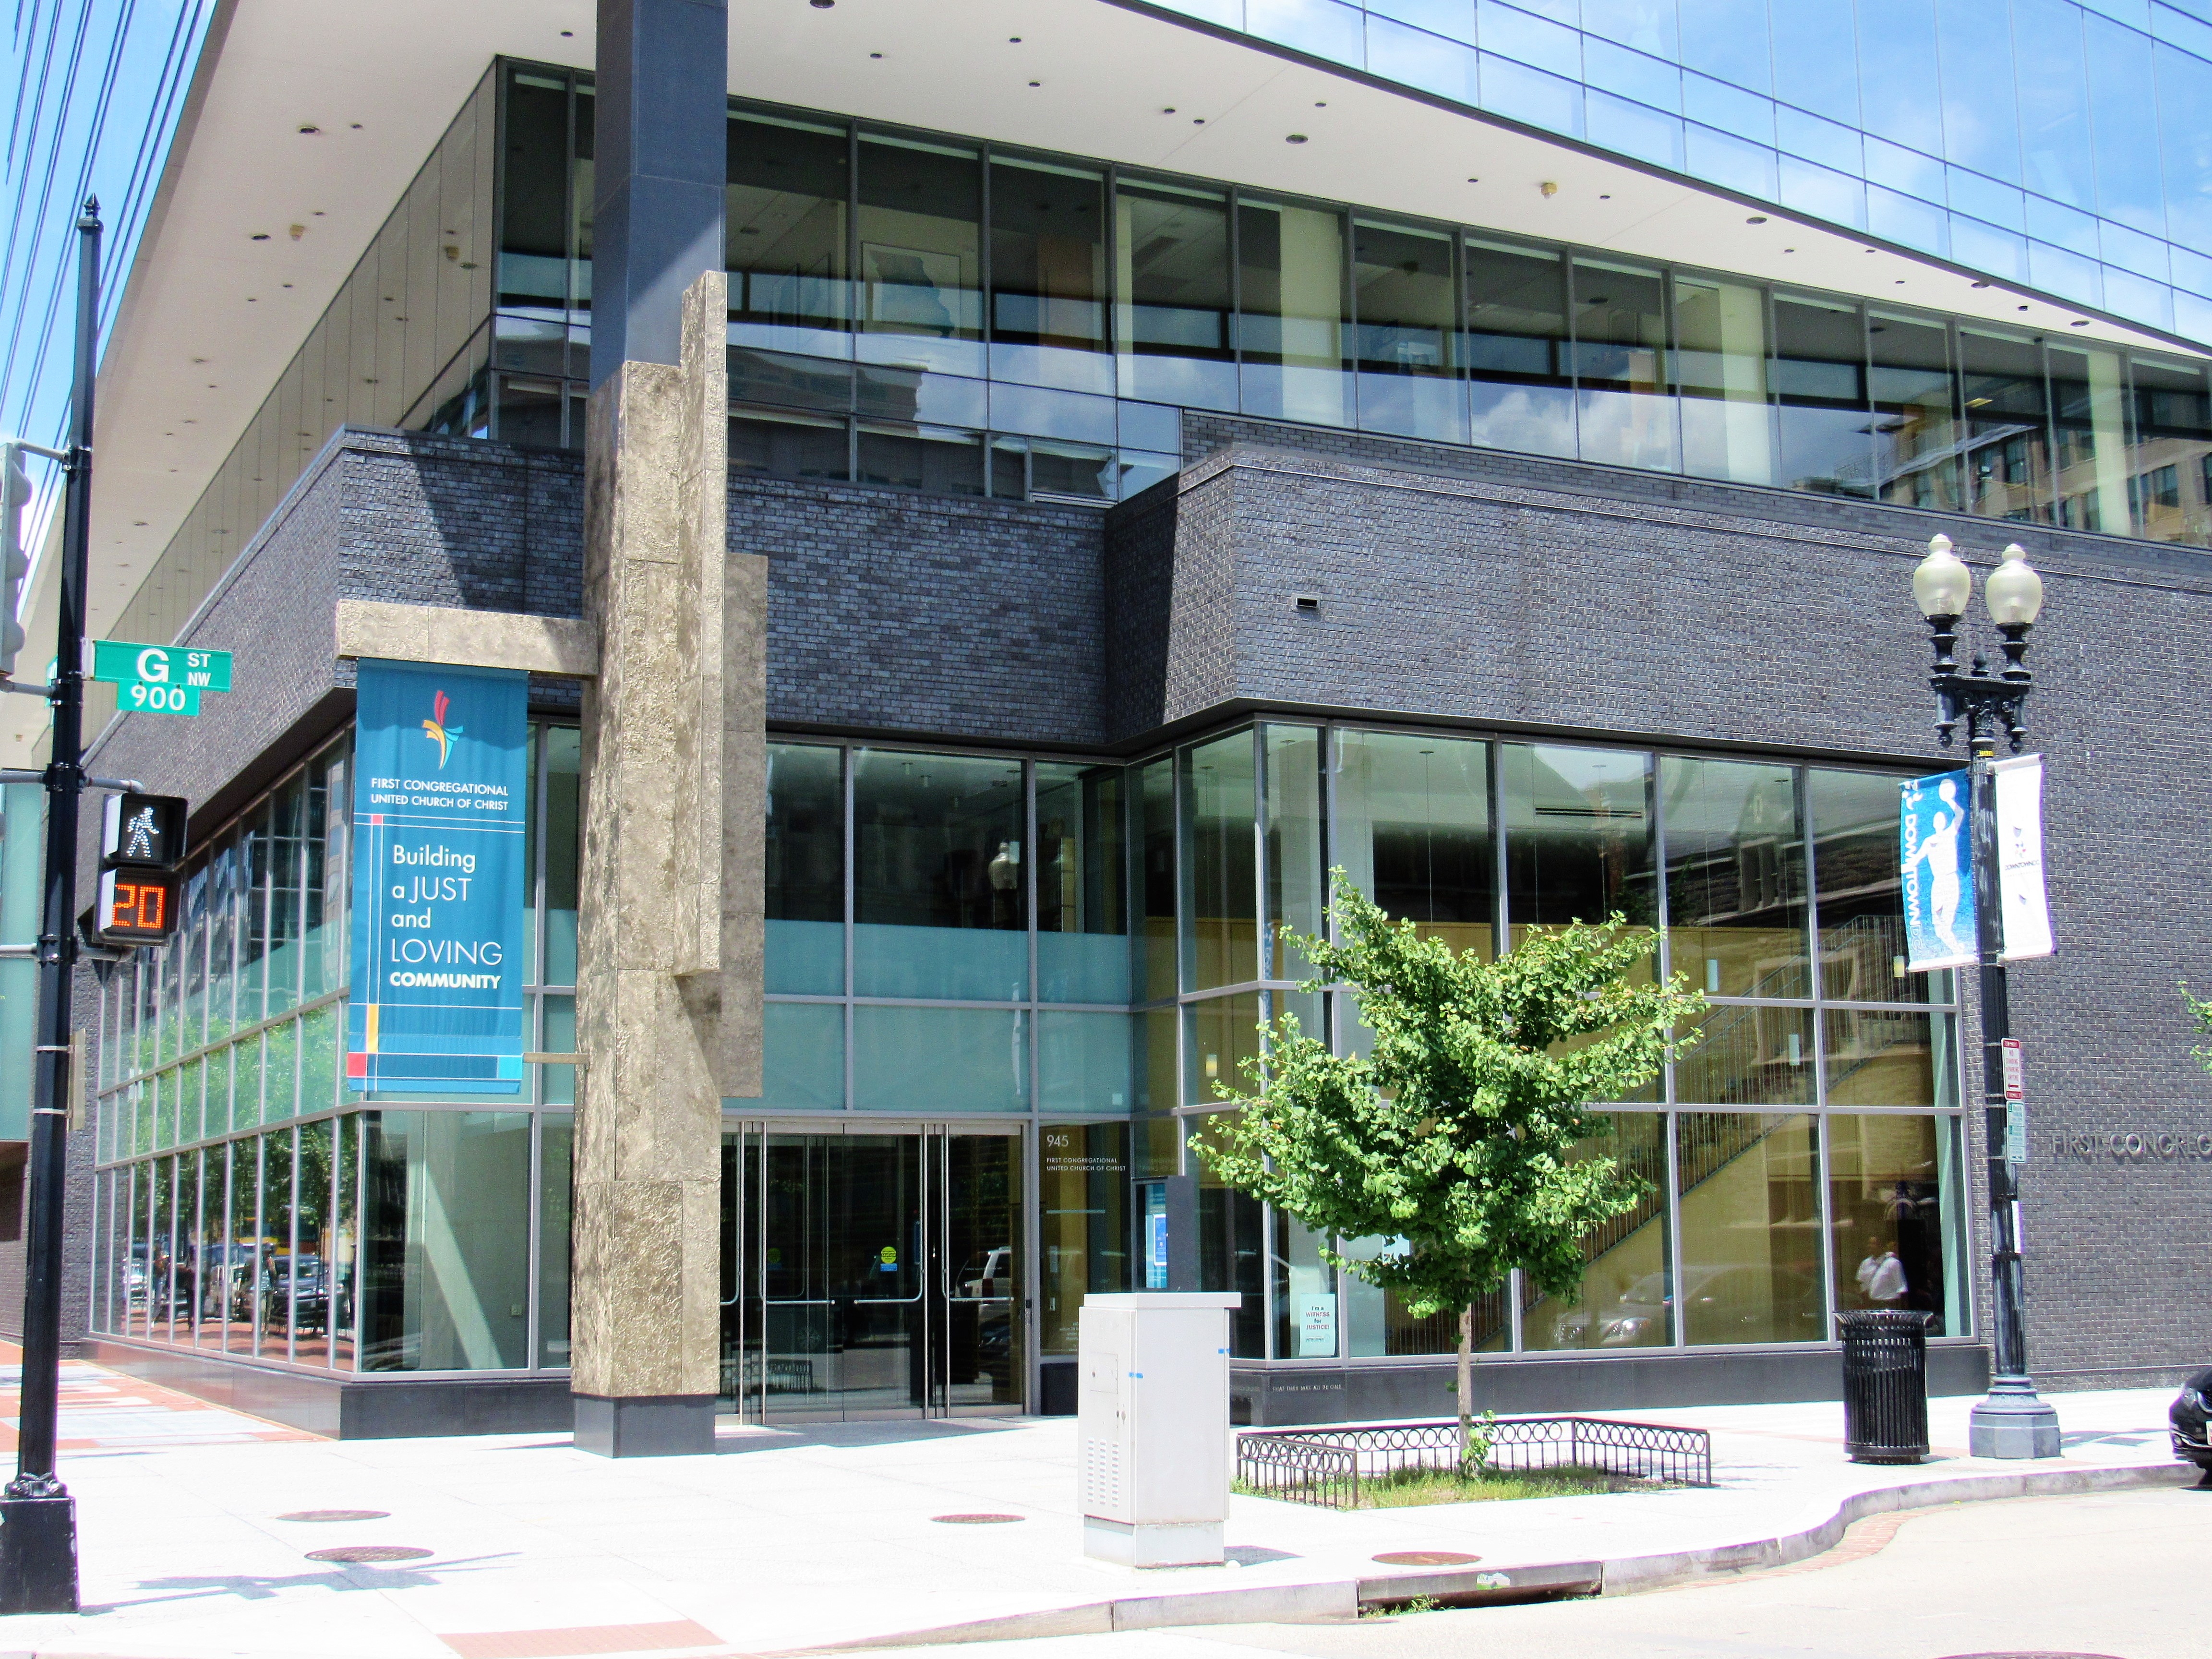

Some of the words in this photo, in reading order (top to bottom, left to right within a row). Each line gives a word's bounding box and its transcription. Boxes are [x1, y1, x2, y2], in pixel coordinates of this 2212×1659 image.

[137, 648, 169, 682] G
[188, 652, 211, 667] ST
[188, 672, 211, 686] NW
[131, 685, 186, 710] 900
[371, 778, 400, 789] FIRST
[404, 780, 509, 796] CONGREGATIONAL
[371, 794, 408, 805] UNITED
[412, 796, 454, 807] CHURCH
[457, 798, 471, 808] OF
[475, 800, 508, 810] CHRIST
[393, 844, 476, 873] Building
[392, 885, 405, 899] a
[409, 876, 472, 903] JUST
[112, 884, 164, 928] 20
[392, 907, 431, 928] and
[392, 938, 503, 965] LOVING
[390, 972, 501, 989] COMMUNITY
[1046, 1135, 1069, 1147] 945
[2052, 1133, 2103, 1155] FIRST
